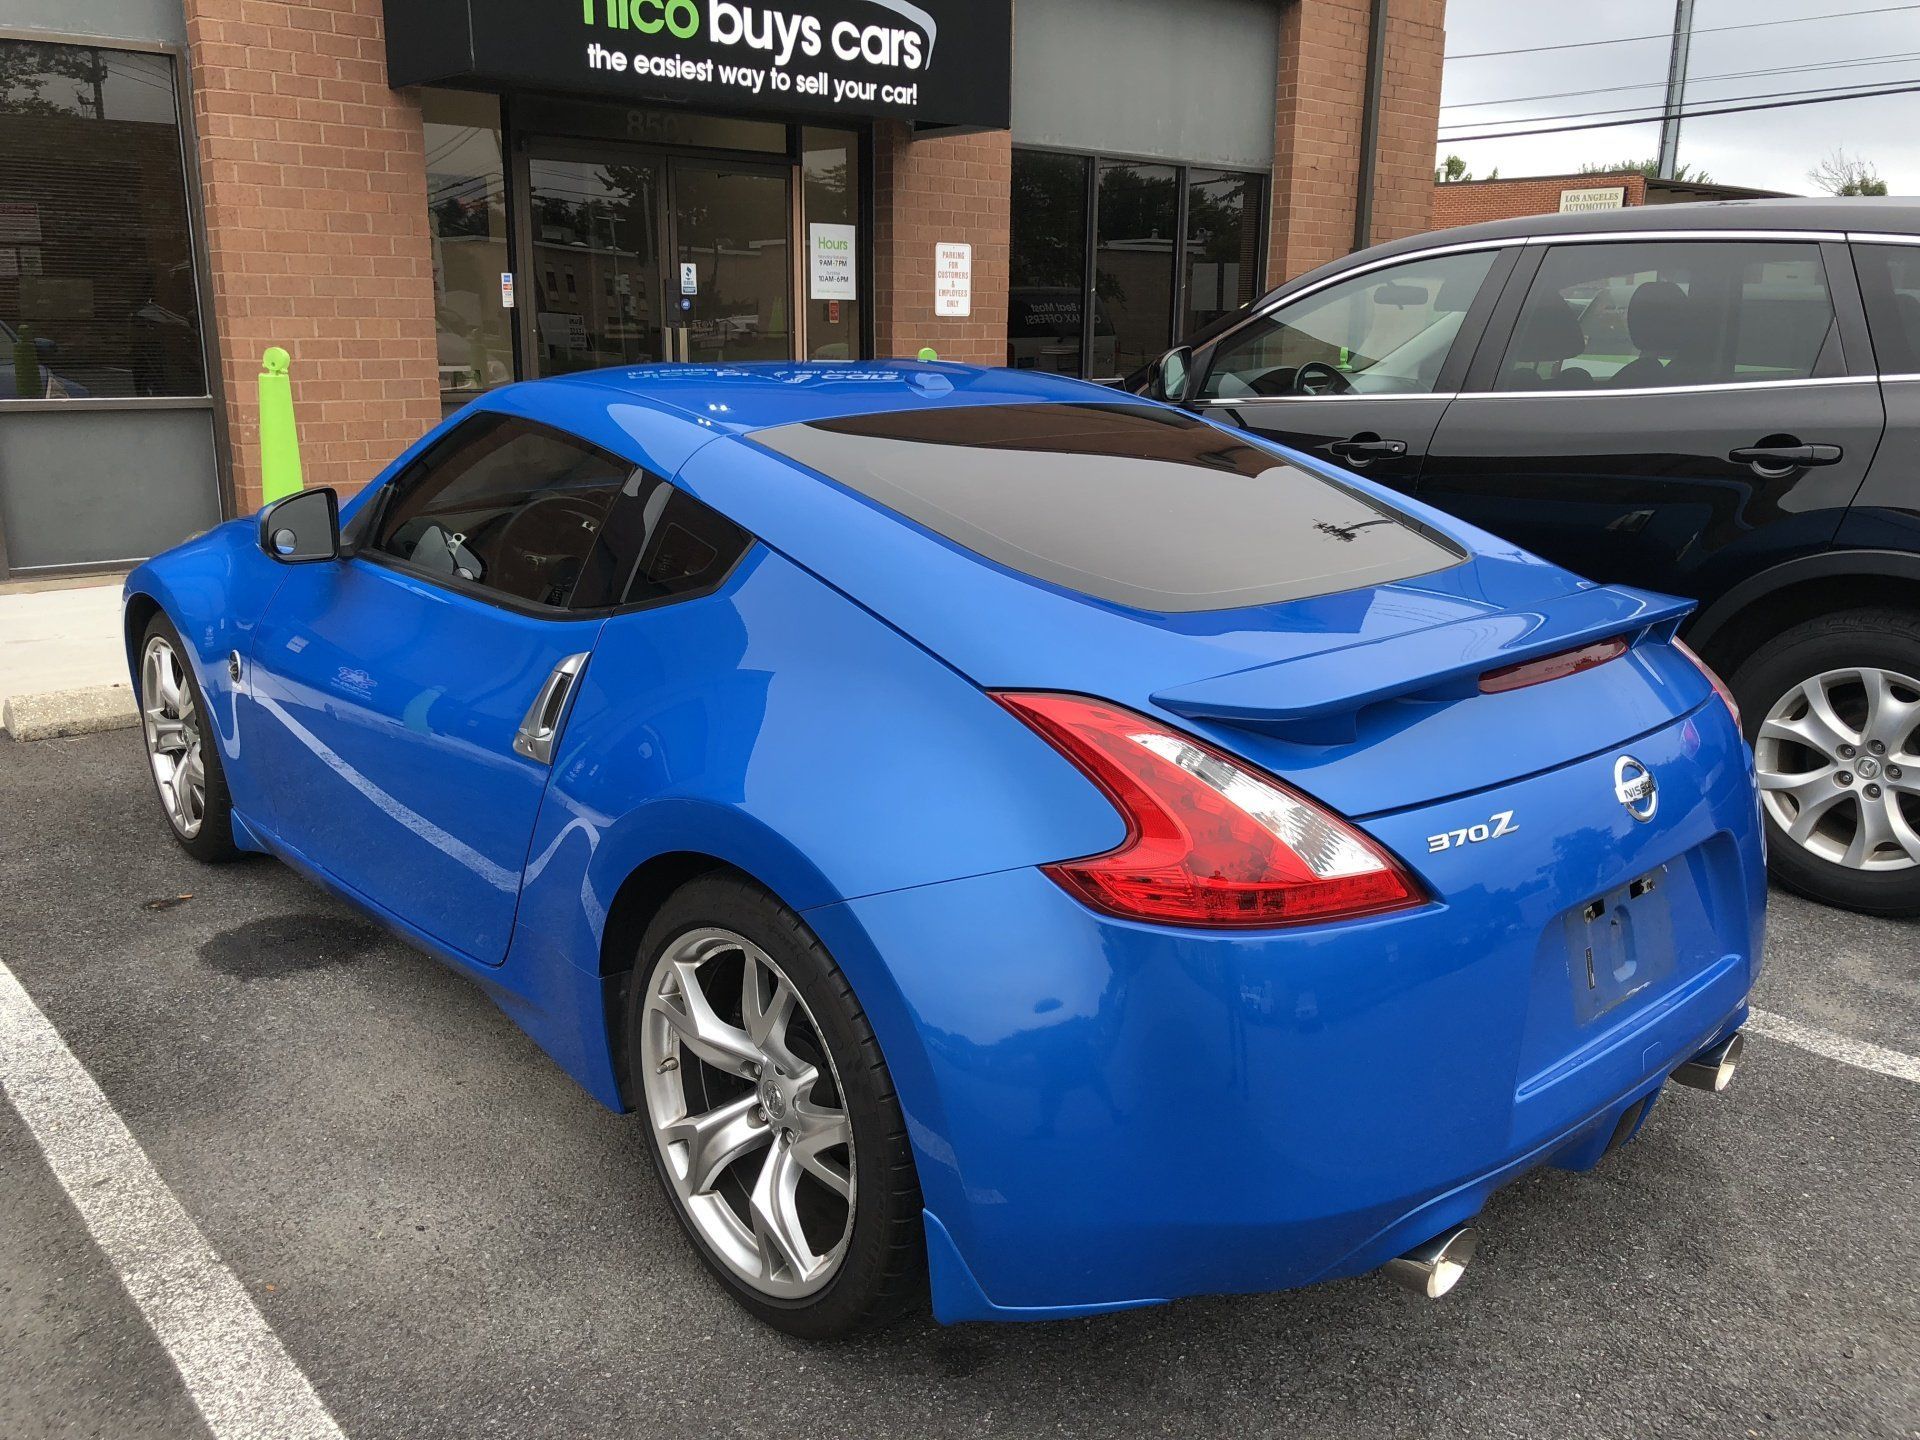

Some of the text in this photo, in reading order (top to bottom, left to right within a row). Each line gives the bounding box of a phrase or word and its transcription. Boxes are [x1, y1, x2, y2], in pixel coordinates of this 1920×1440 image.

[709, 0, 822, 66] buys
[831, 21, 922, 70] cars
[587, 43, 918, 106] the easiest way to sell your car!
[1565, 193, 1619, 203] LOS ANGELES
[1563, 202, 1618, 212] AUTOMOTIVE
[818, 236, 849, 250] Hours
[942, 251, 965, 260] PARKING
[948, 261, 959, 269] FOR
[937, 270, 969, 280] CUSTOMERS
[938, 289, 968, 298] EMPLOYEES
[946, 299, 959, 308] ONLY
[1427, 810, 1520, 853] 370Z
